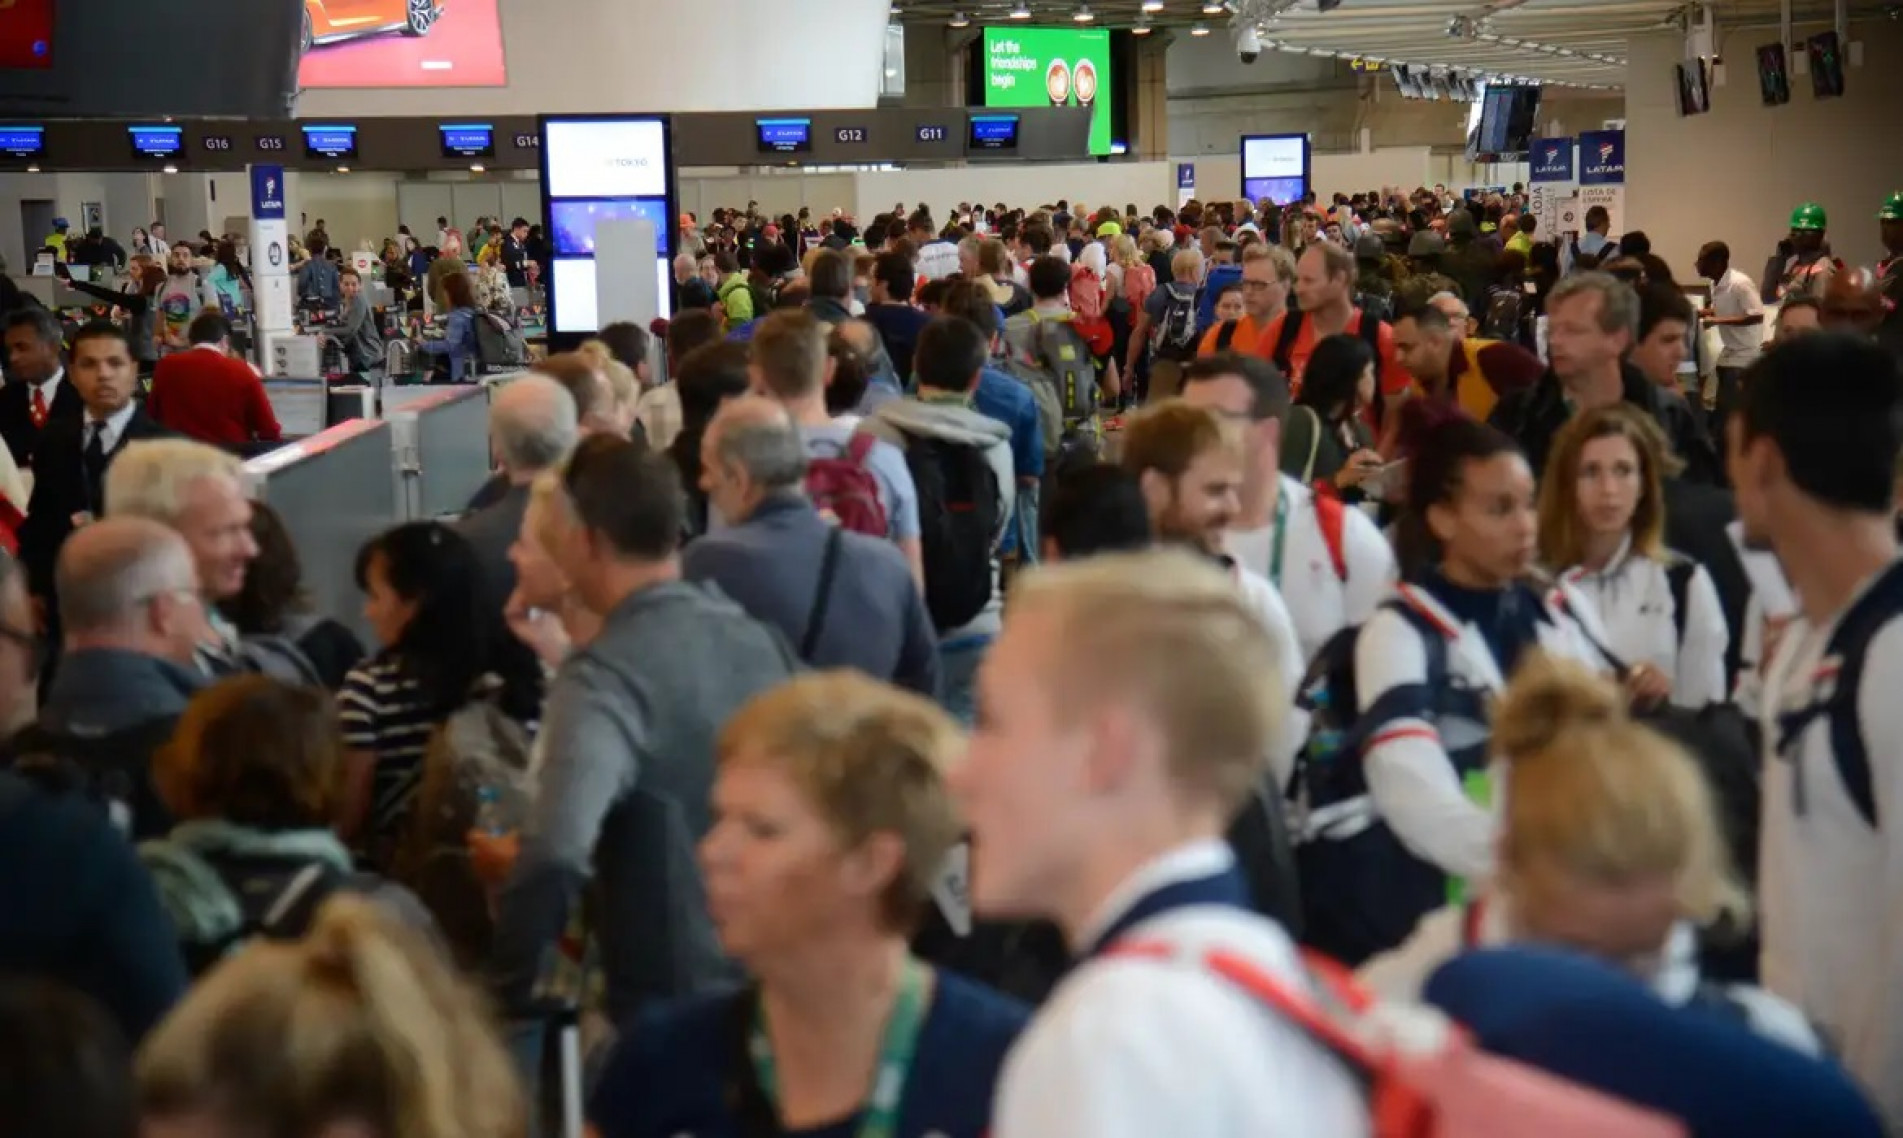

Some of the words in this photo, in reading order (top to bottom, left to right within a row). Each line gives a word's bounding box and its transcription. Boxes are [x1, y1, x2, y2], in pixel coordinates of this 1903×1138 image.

[990, 40, 1004, 53] Let
[991, 73, 1016, 88] begin
[838, 130, 863, 141] G12
[920, 128, 942, 139] G11
[206, 138, 229, 149] G16
[259, 138, 282, 149] G15
[516, 136, 539, 147] G14
[1535, 165, 1567, 173] LATAM
[1586, 165, 1624, 174] LATAM
